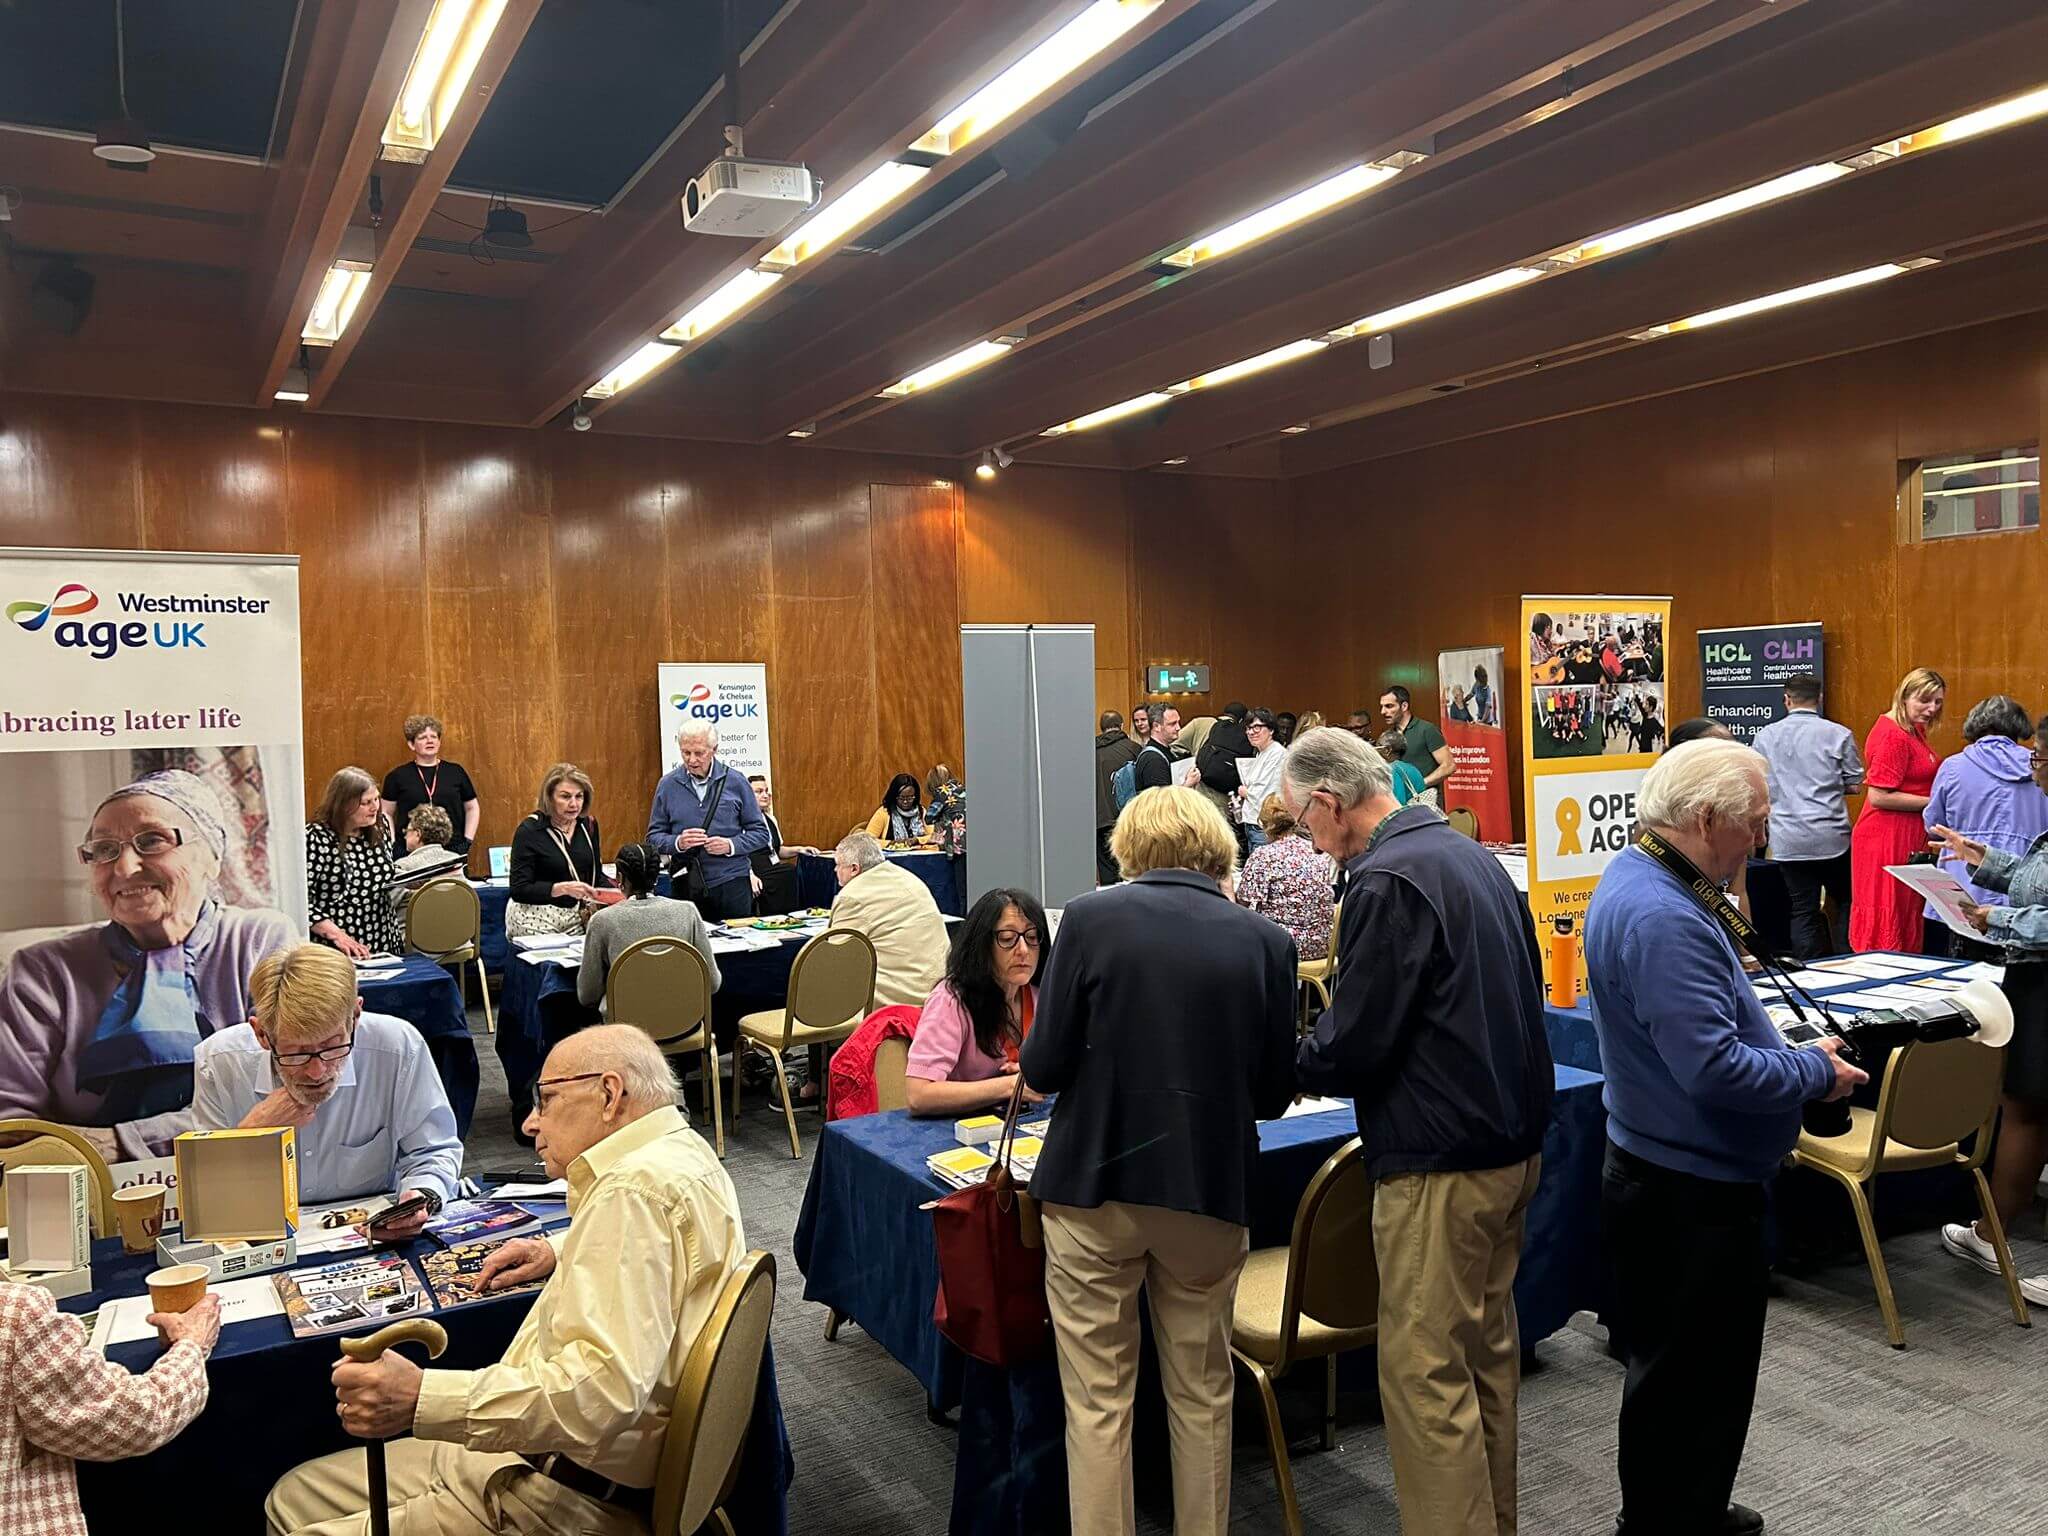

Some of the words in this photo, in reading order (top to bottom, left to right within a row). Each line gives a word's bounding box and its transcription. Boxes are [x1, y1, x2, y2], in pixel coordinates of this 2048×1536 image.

[118, 593, 270, 613] Westminster
[54, 621, 148, 660] age
[154, 622, 207, 648] UK
[1763, 639, 1814, 660] CLH
[1705, 642, 1752, 663] HCL
[1706, 666, 1752, 676] Healthcare
[718, 683, 756, 692] Kensington
[726, 692, 753, 700] Chelsea
[124, 708, 191, 731] later
[199, 707, 242, 729] life
[691, 703, 733, 724] age
[735, 703, 759, 717] UK
[1707, 703, 1772, 719] Enhancing
[721, 733, 745, 742] better
[746, 732, 758, 741] for
[729, 759, 763, 767] Chelsea
[1589, 792, 1636, 822] OPE
[1553, 891, 1570, 905] We
[1572, 890, 1593, 903] crea
[1538, 910, 1586, 924] Londone
[1719, 905, 1751, 937] Nikon
[121, 1170, 178, 1189] olde
